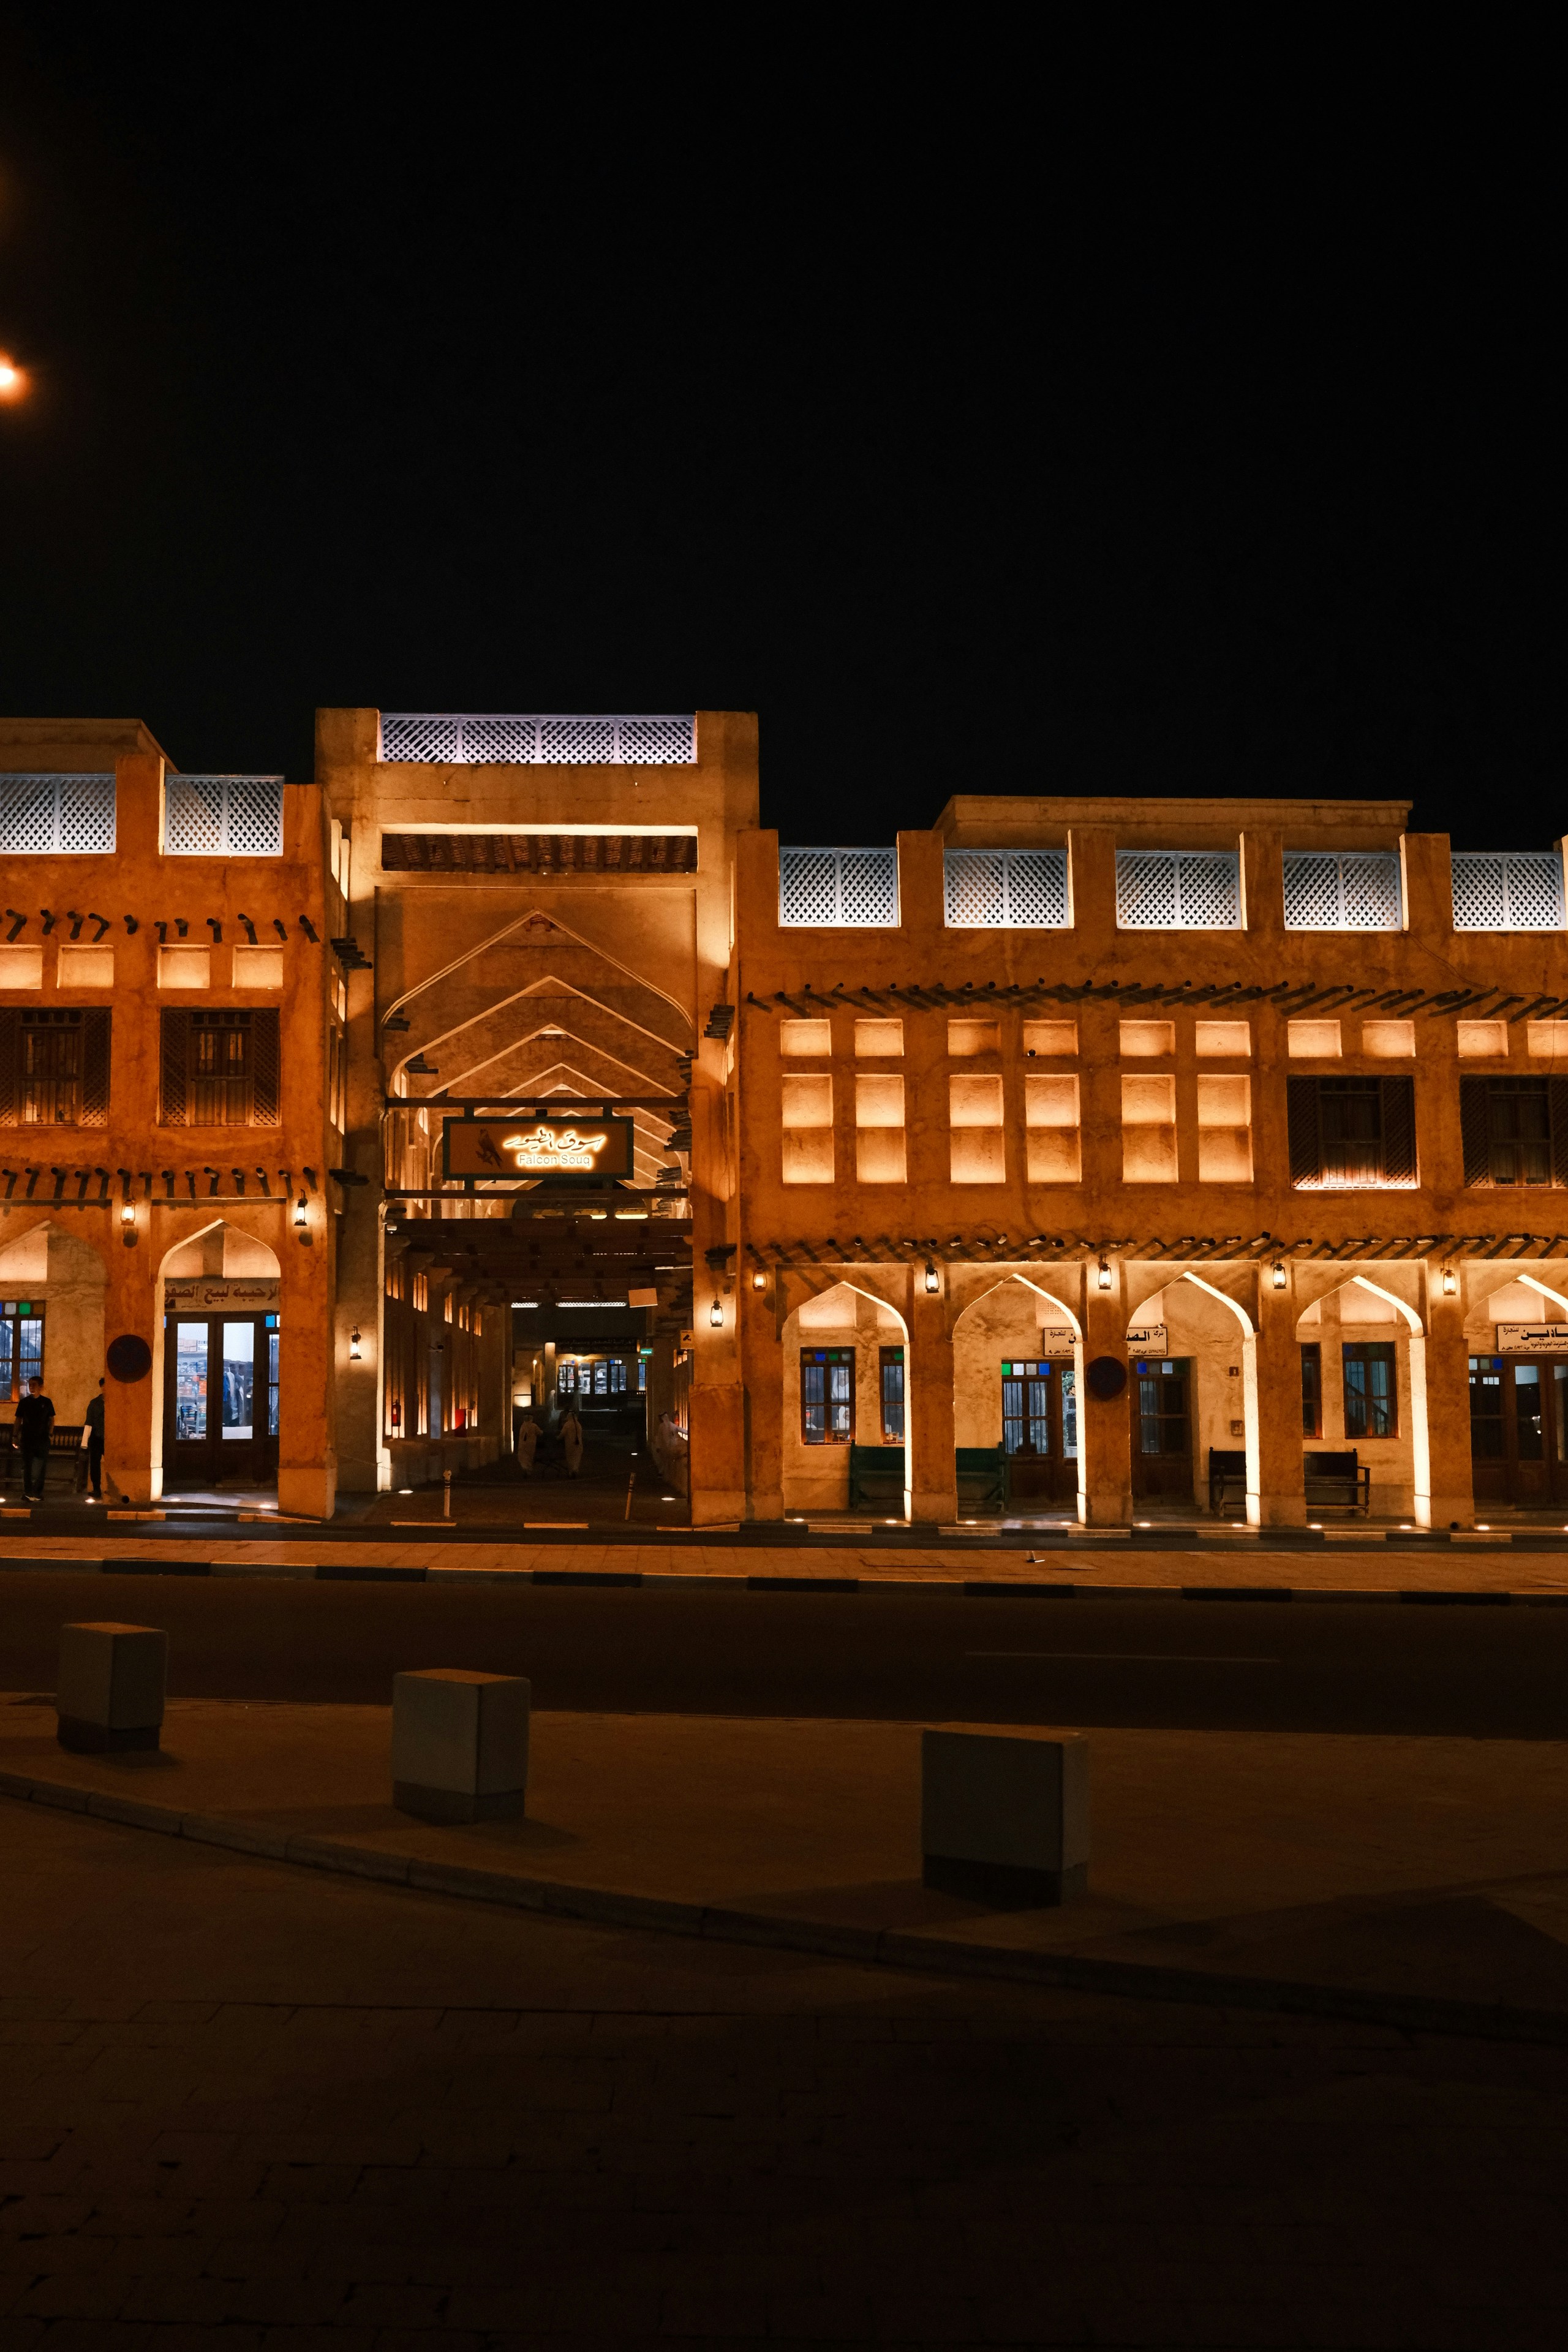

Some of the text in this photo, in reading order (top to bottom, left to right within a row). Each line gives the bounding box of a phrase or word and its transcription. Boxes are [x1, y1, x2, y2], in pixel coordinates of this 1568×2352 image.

[504, 1129, 606, 1151] سوق الطيور
[519, 1155, 590, 1166] Falcon Souq
[204, 1285, 230, 1305] لبيع
